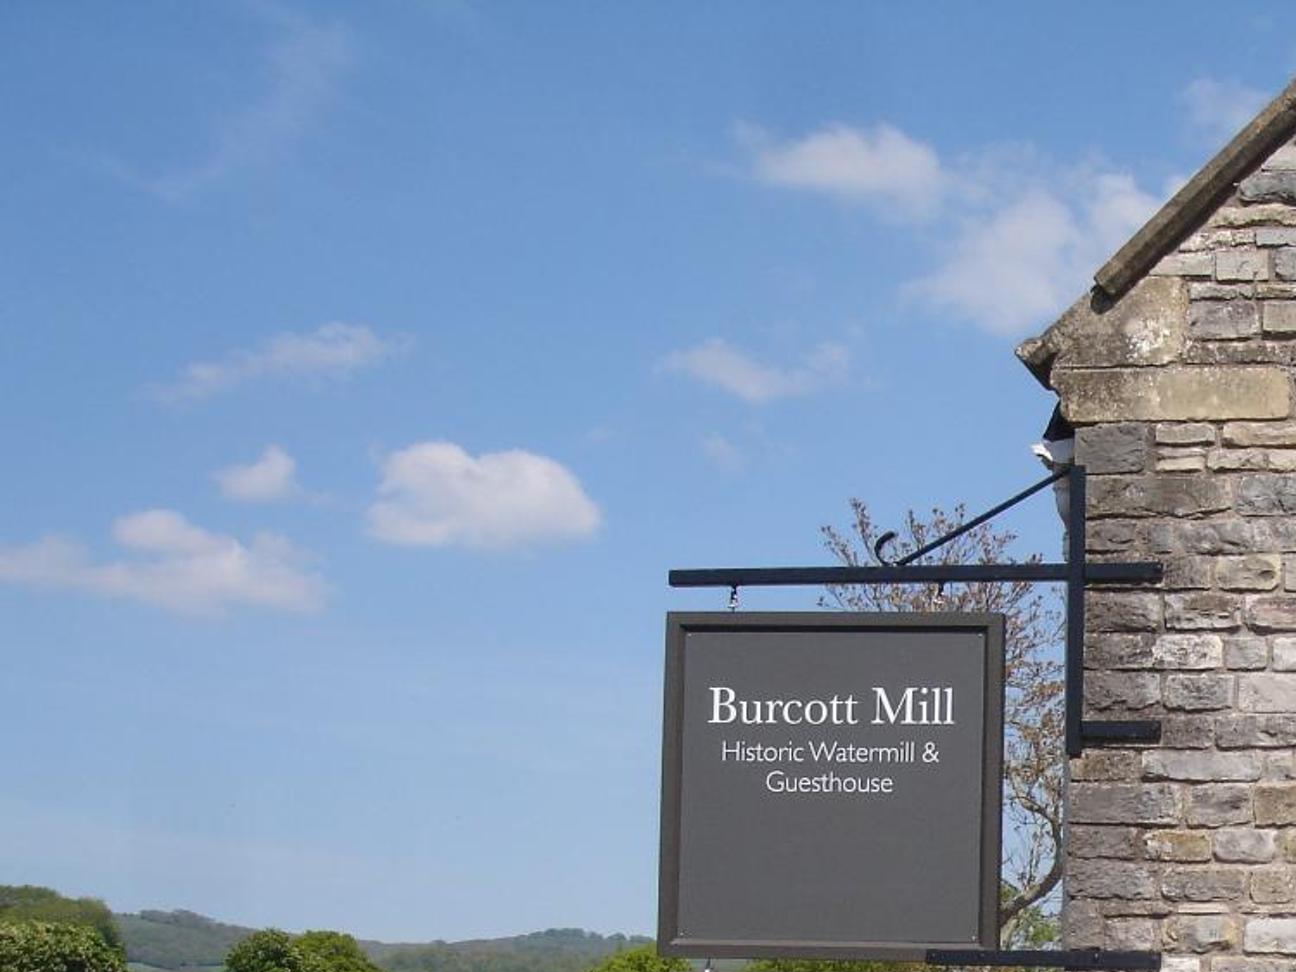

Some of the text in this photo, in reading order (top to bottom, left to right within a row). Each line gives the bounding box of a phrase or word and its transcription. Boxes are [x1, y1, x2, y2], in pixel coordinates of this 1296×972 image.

[707, 686, 955, 725] Burcott Mill
[721, 740, 940, 763] Historic Watermill &
[766, 770, 893, 793] Guesthouse
